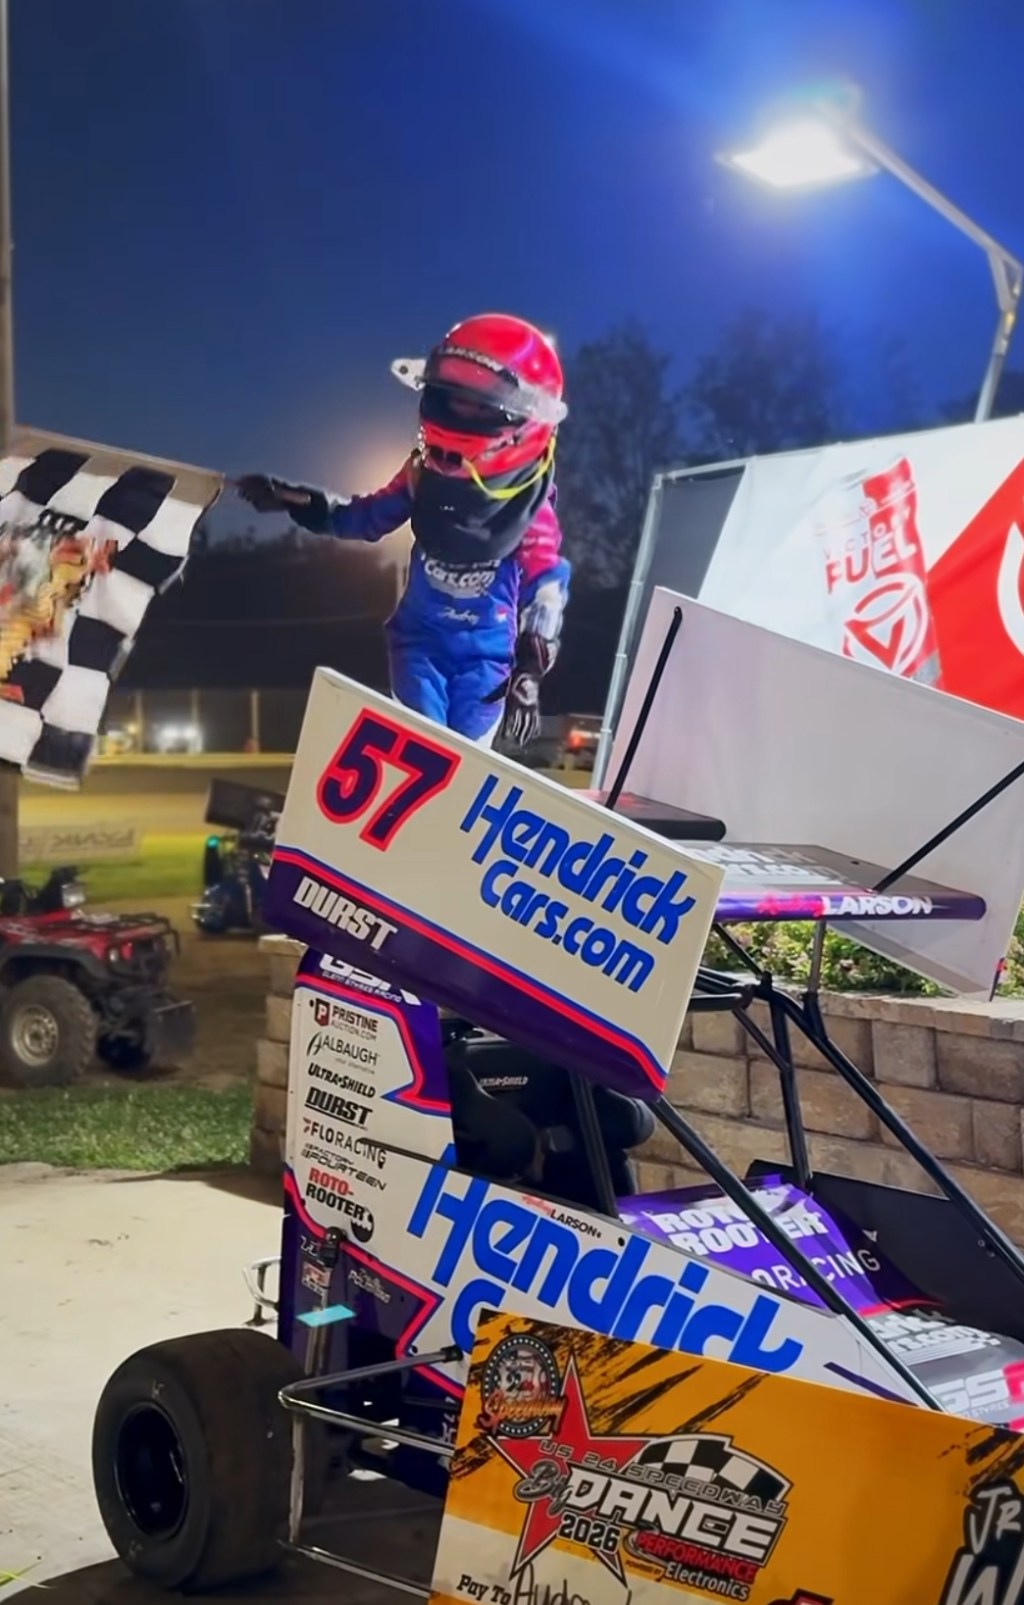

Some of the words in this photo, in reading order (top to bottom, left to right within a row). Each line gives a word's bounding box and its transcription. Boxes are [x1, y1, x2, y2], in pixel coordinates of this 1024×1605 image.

[825, 512, 908, 595] FUEL
[316, 707, 462, 852] 57
[459, 773, 697, 946] Hendrick
[292, 876, 399, 951] DURST
[479, 858, 655, 994] Cars.com
[822, 896, 934, 917] LARSON
[331, 1005, 379, 1033] PRISTINE
[322, 1035, 378, 1067] ALBAUGH
[305, 1086, 374, 1126] DURST
[305, 1182, 366, 1222] ROOTER
[308, 1167, 355, 1197] ROTO-
[550, 1209, 598, 1238] LARSON
[515, 1460, 573, 1517] Big
[540, 1439, 572, 1460] US
[583, 1452, 618, 1472] 24
[628, 1463, 788, 1517] SPEEDWAY
[557, 1512, 621, 1554] 2026
[564, 1465, 784, 1562] DANCE
[636, 1531, 759, 1583] PERFORMANCE
[456, 1573, 490, 1601] Pay
[492, 1585, 512, 1605] To
[665, 1560, 749, 1602] Electronics
